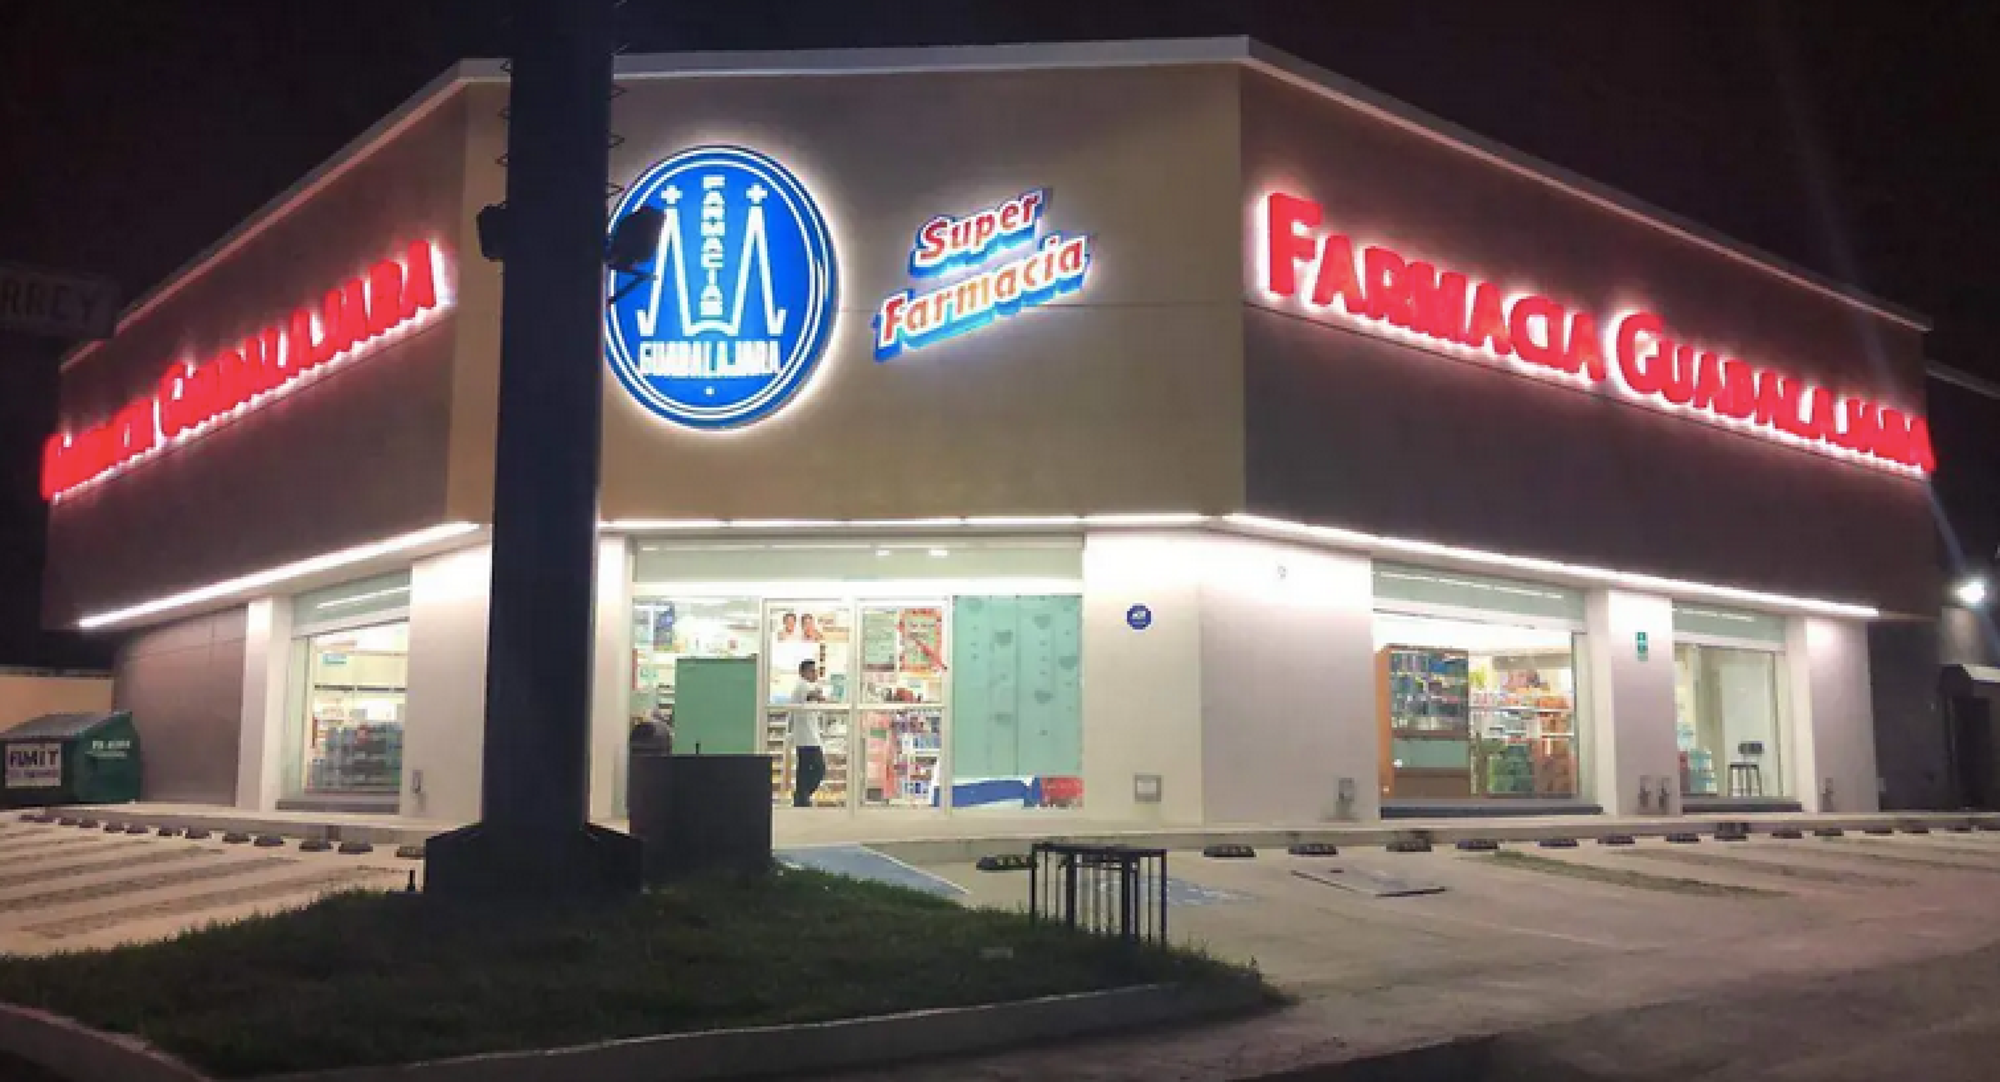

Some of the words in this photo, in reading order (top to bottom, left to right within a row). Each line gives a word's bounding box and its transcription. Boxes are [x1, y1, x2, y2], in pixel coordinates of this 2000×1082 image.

[917, 191, 1041, 262] Super
[883, 236, 1086, 344] Farmacia
[1268, 191, 1606, 382] FARMACIA
